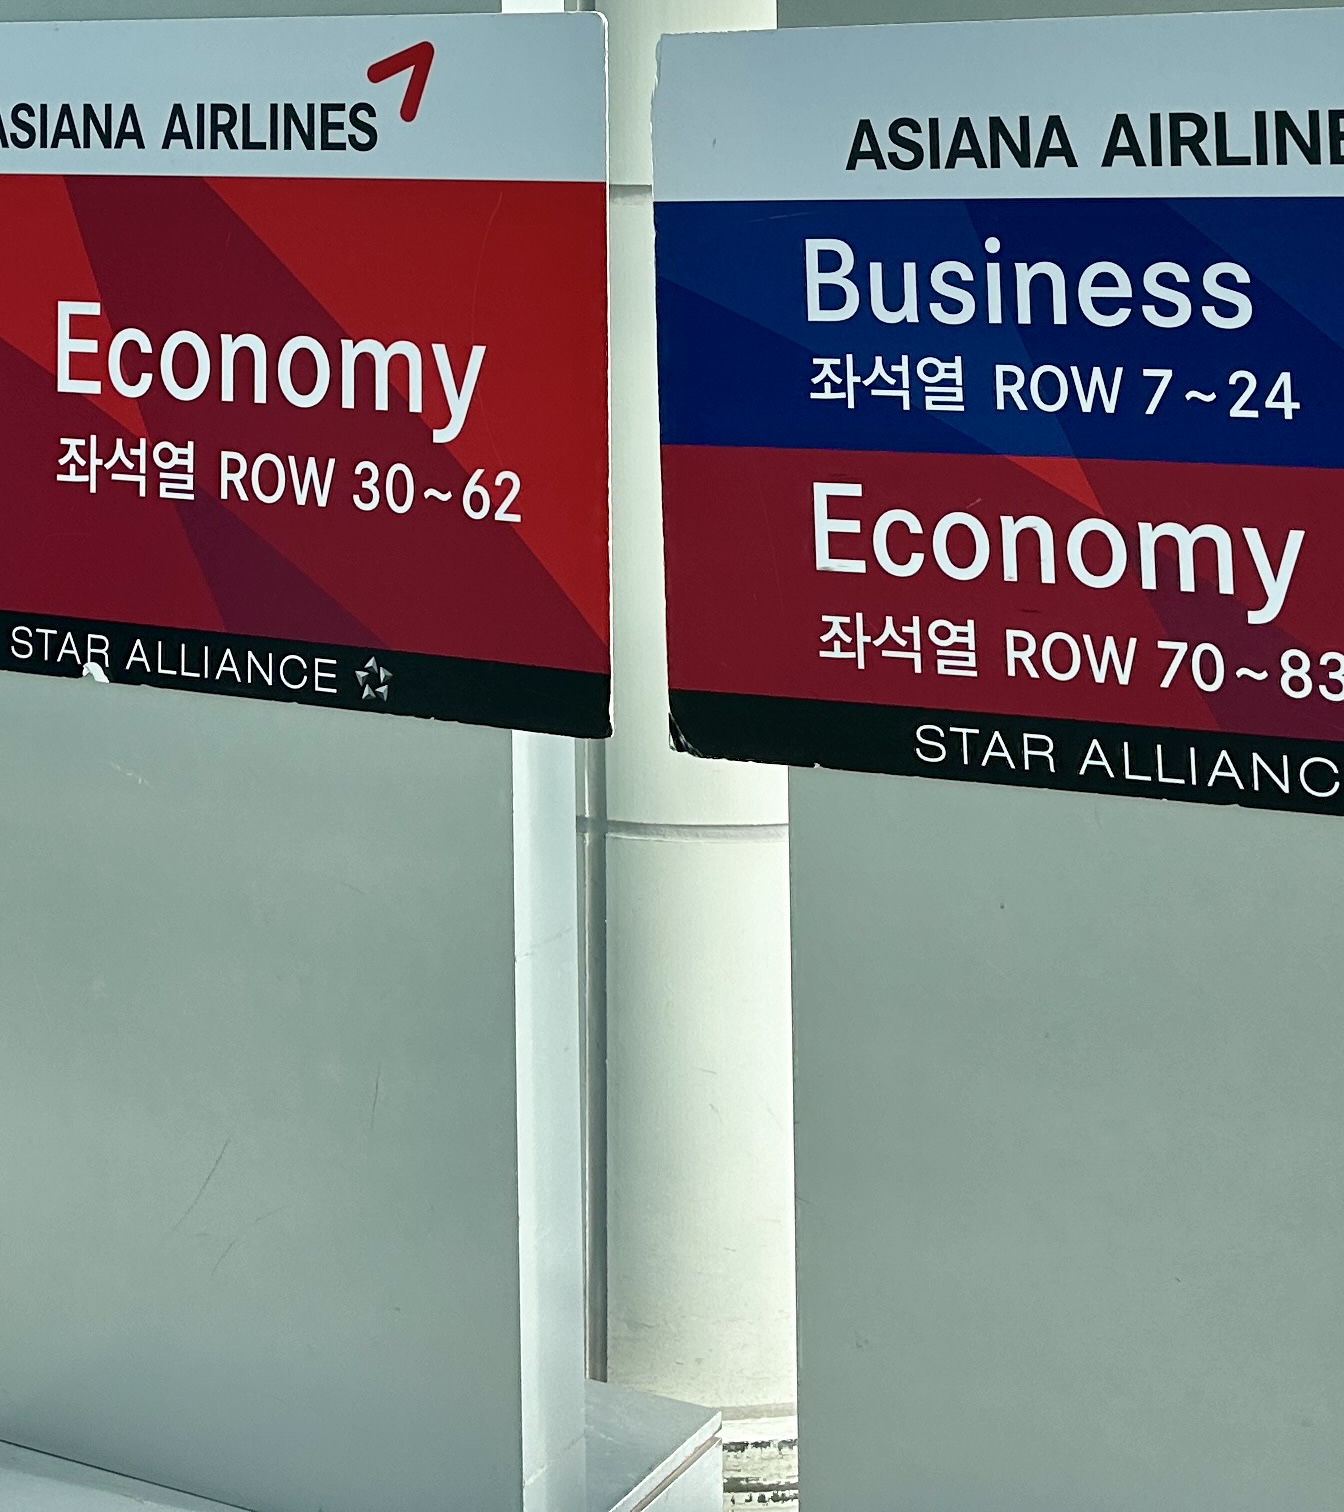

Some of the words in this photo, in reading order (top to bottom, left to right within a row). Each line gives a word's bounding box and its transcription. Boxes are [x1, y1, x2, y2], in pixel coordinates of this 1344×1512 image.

[160, 101, 379, 153] AIRLINES
[844, 114, 1080, 172] ASIANA
[804, 235, 1255, 331] Business
[56, 299, 488, 445] Economy
[808, 352, 967, 413] 좌석열
[994, 363, 1125, 415] ROW
[1141, 367, 1303, 421] 7~24
[56, 433, 197, 502] 좌석열
[219, 449, 337, 508] ROW
[351, 459, 524, 524] 30~62
[812, 480, 1307, 626] Economy
[10, 624, 111, 668] STAR
[124, 637, 338, 695] ALLIANCE
[818, 611, 978, 678] 좌석열
[1004, 628, 1138, 686] ROW
[914, 723, 1057, 774] STAR
